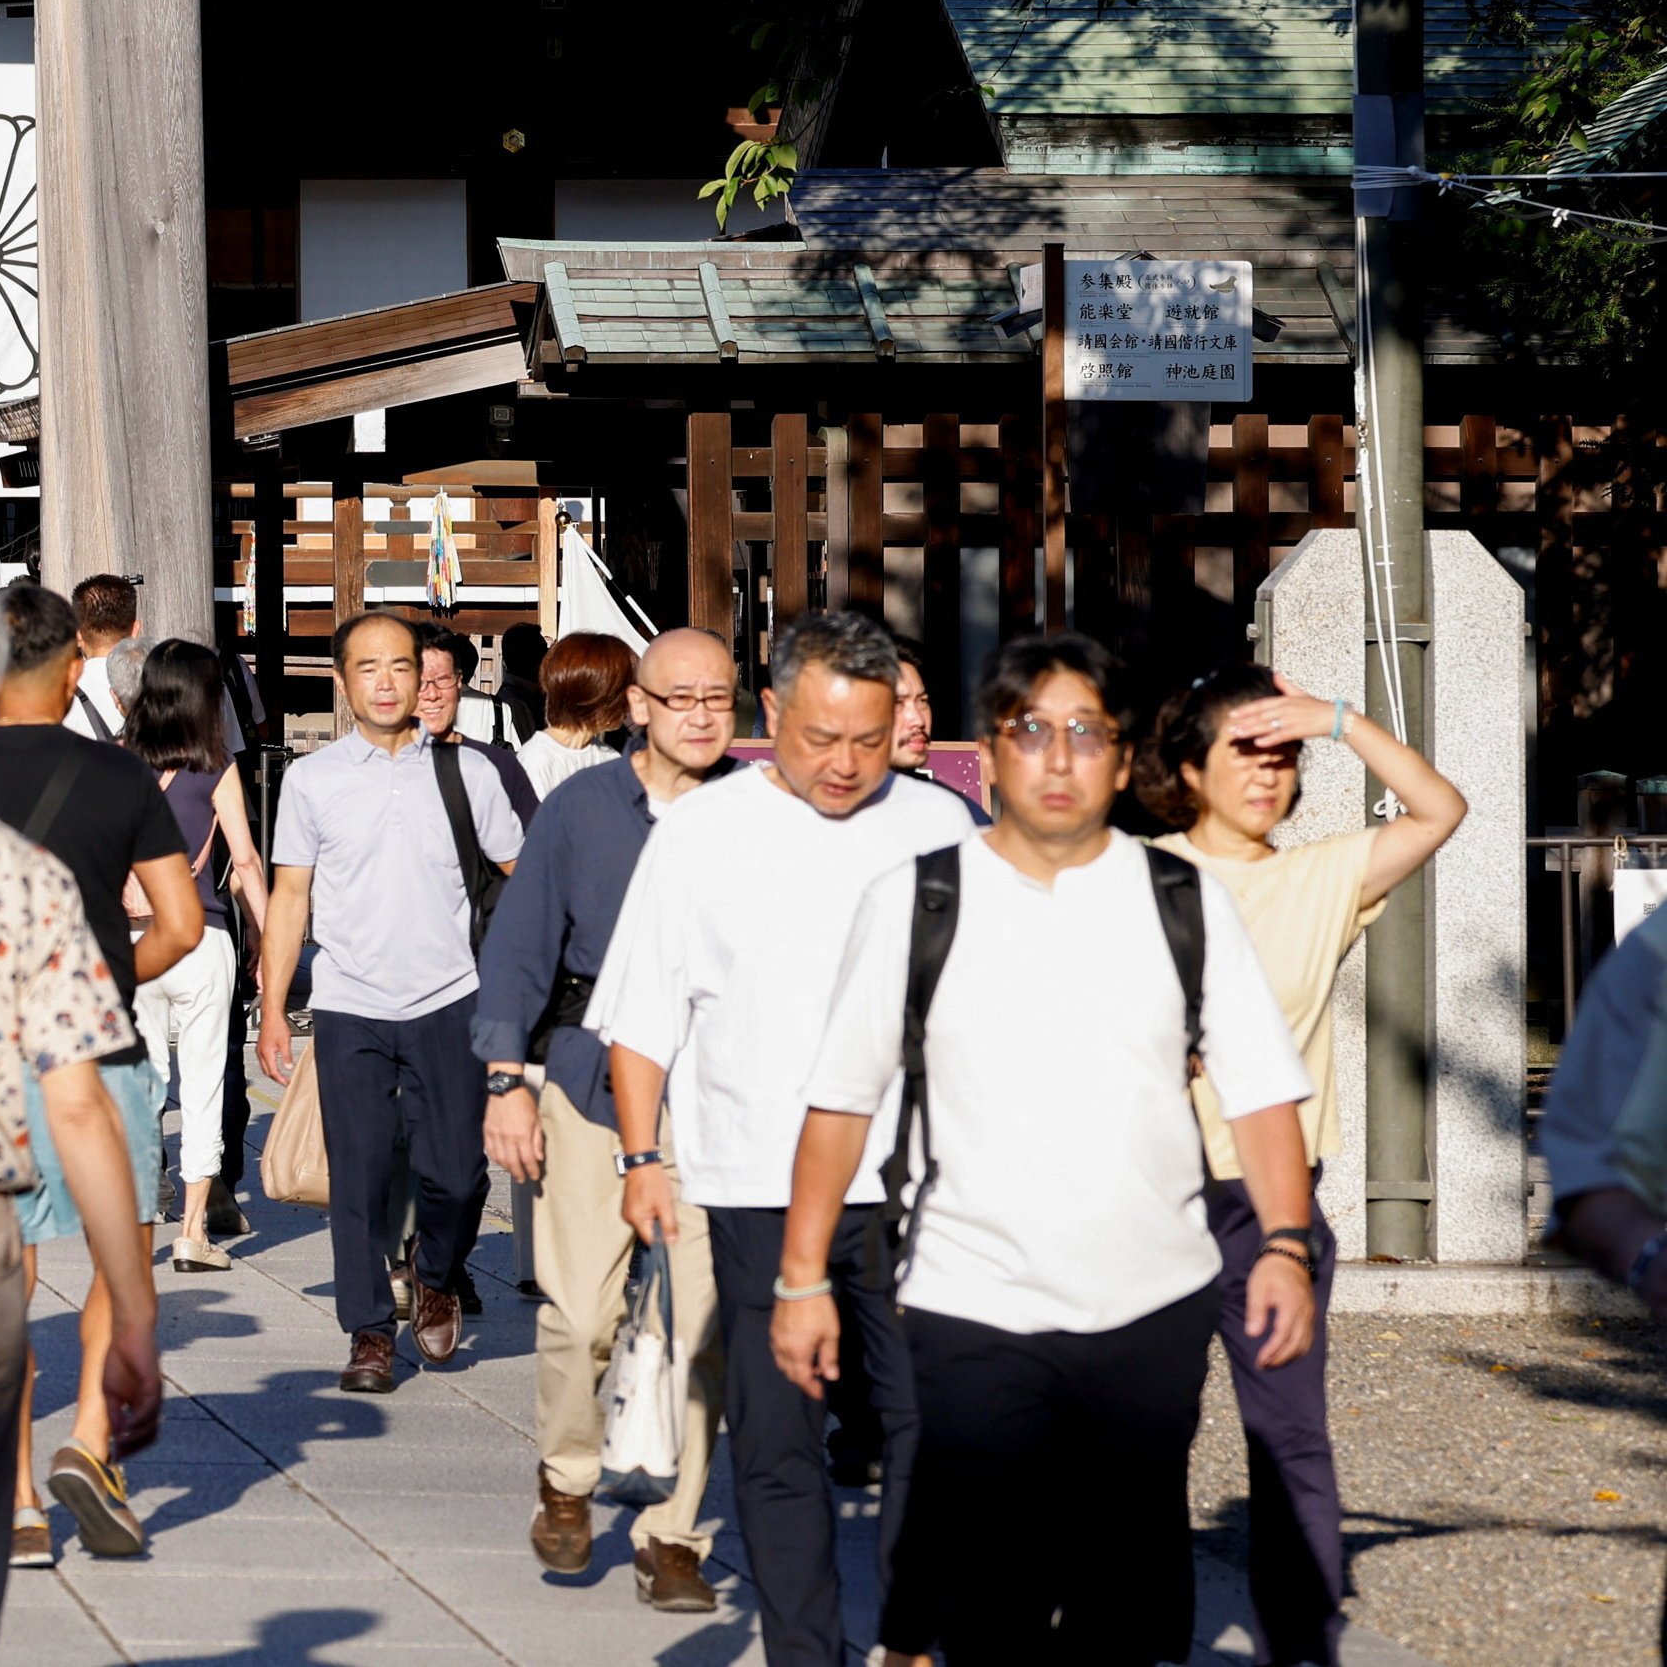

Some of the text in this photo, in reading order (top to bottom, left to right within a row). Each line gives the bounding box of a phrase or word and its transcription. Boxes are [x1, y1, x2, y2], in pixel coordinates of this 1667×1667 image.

[1079, 273, 1133, 291] 参集殿
[1079, 302, 1133, 320] 能楽堂
[1165, 303, 1220, 321] 遊就館
[1080, 362, 1134, 379] 啓照館
[1165, 362, 1235, 381] 神池庭園
